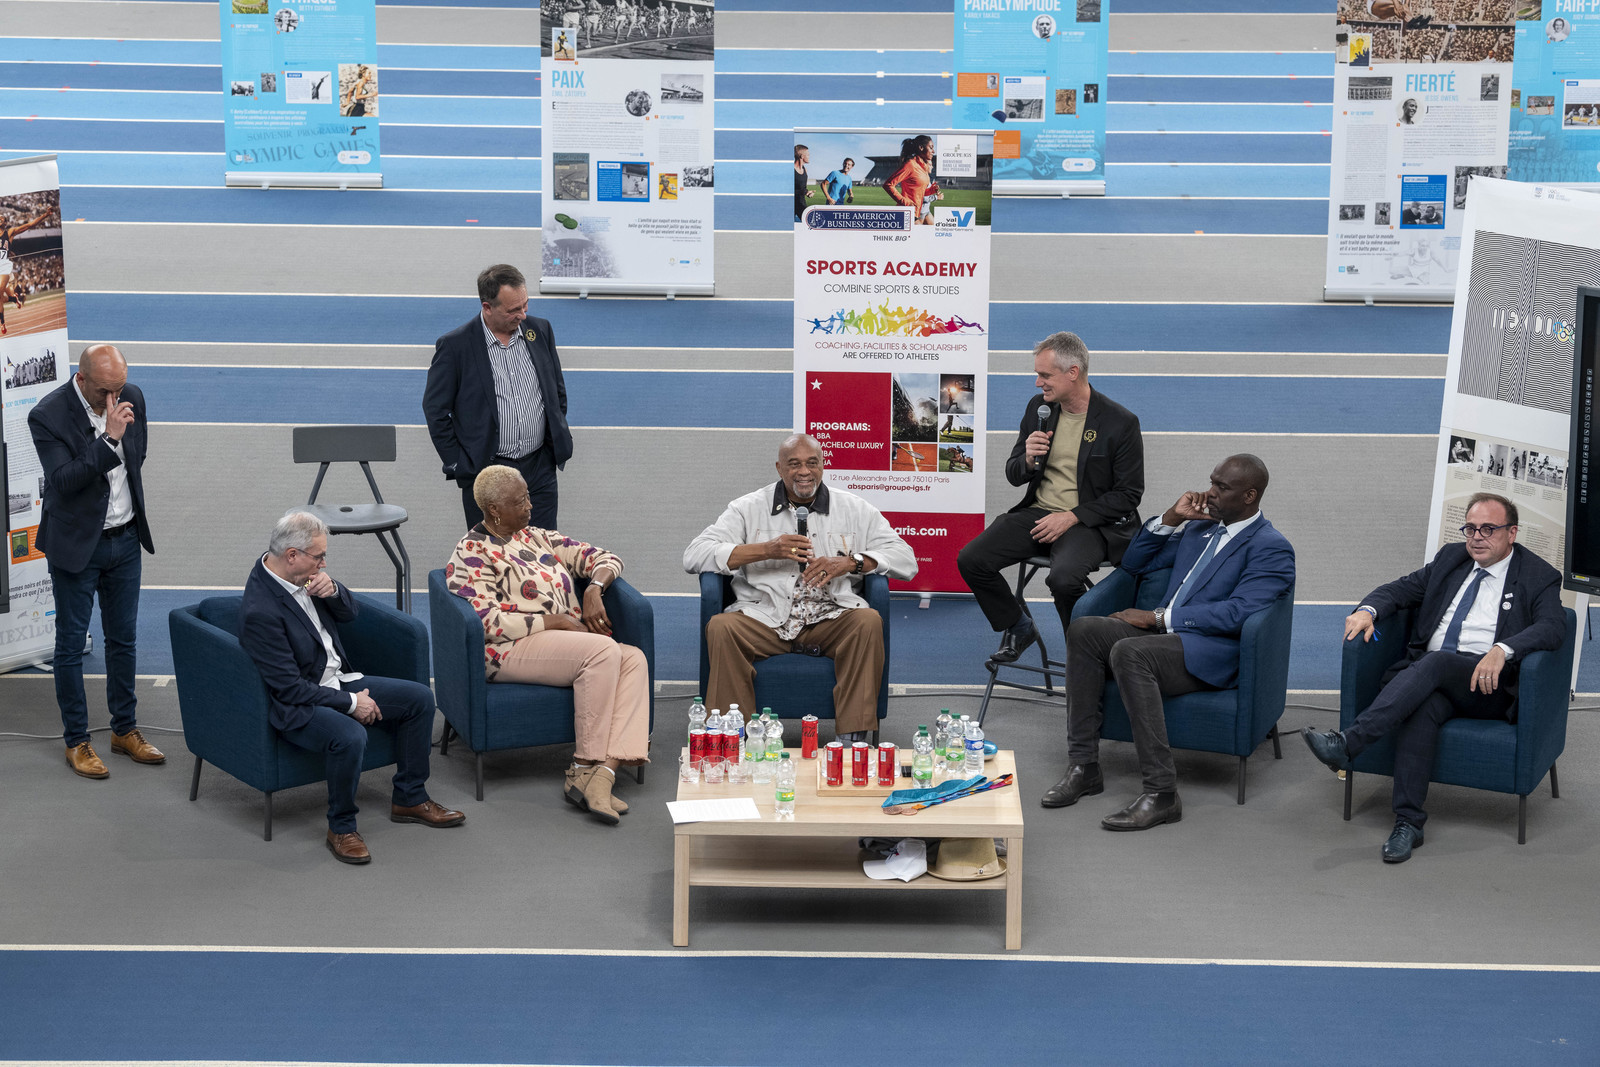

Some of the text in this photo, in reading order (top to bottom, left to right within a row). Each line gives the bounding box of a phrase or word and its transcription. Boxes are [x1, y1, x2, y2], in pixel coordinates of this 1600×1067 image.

[964, 0, 1061, 12] PARALYMPIQUE
[552, 70, 584, 88] PAIX
[1406, 70, 1456, 92] FIERTÉ
[229, 138, 377, 166] OLYMPIC GAMES
[806, 260, 977, 277] SPORTS ACADEMY
[824, 284, 960, 295] COMBINE SPORTS & STUDIES
[909, 343, 967, 351] SCHOLARSHIPS
[810, 422, 871, 431] PROGRAMS:
[848, 484, 930, 492] absparis@groupe-igs.fr
[894, 525, 947, 536] aris.com
